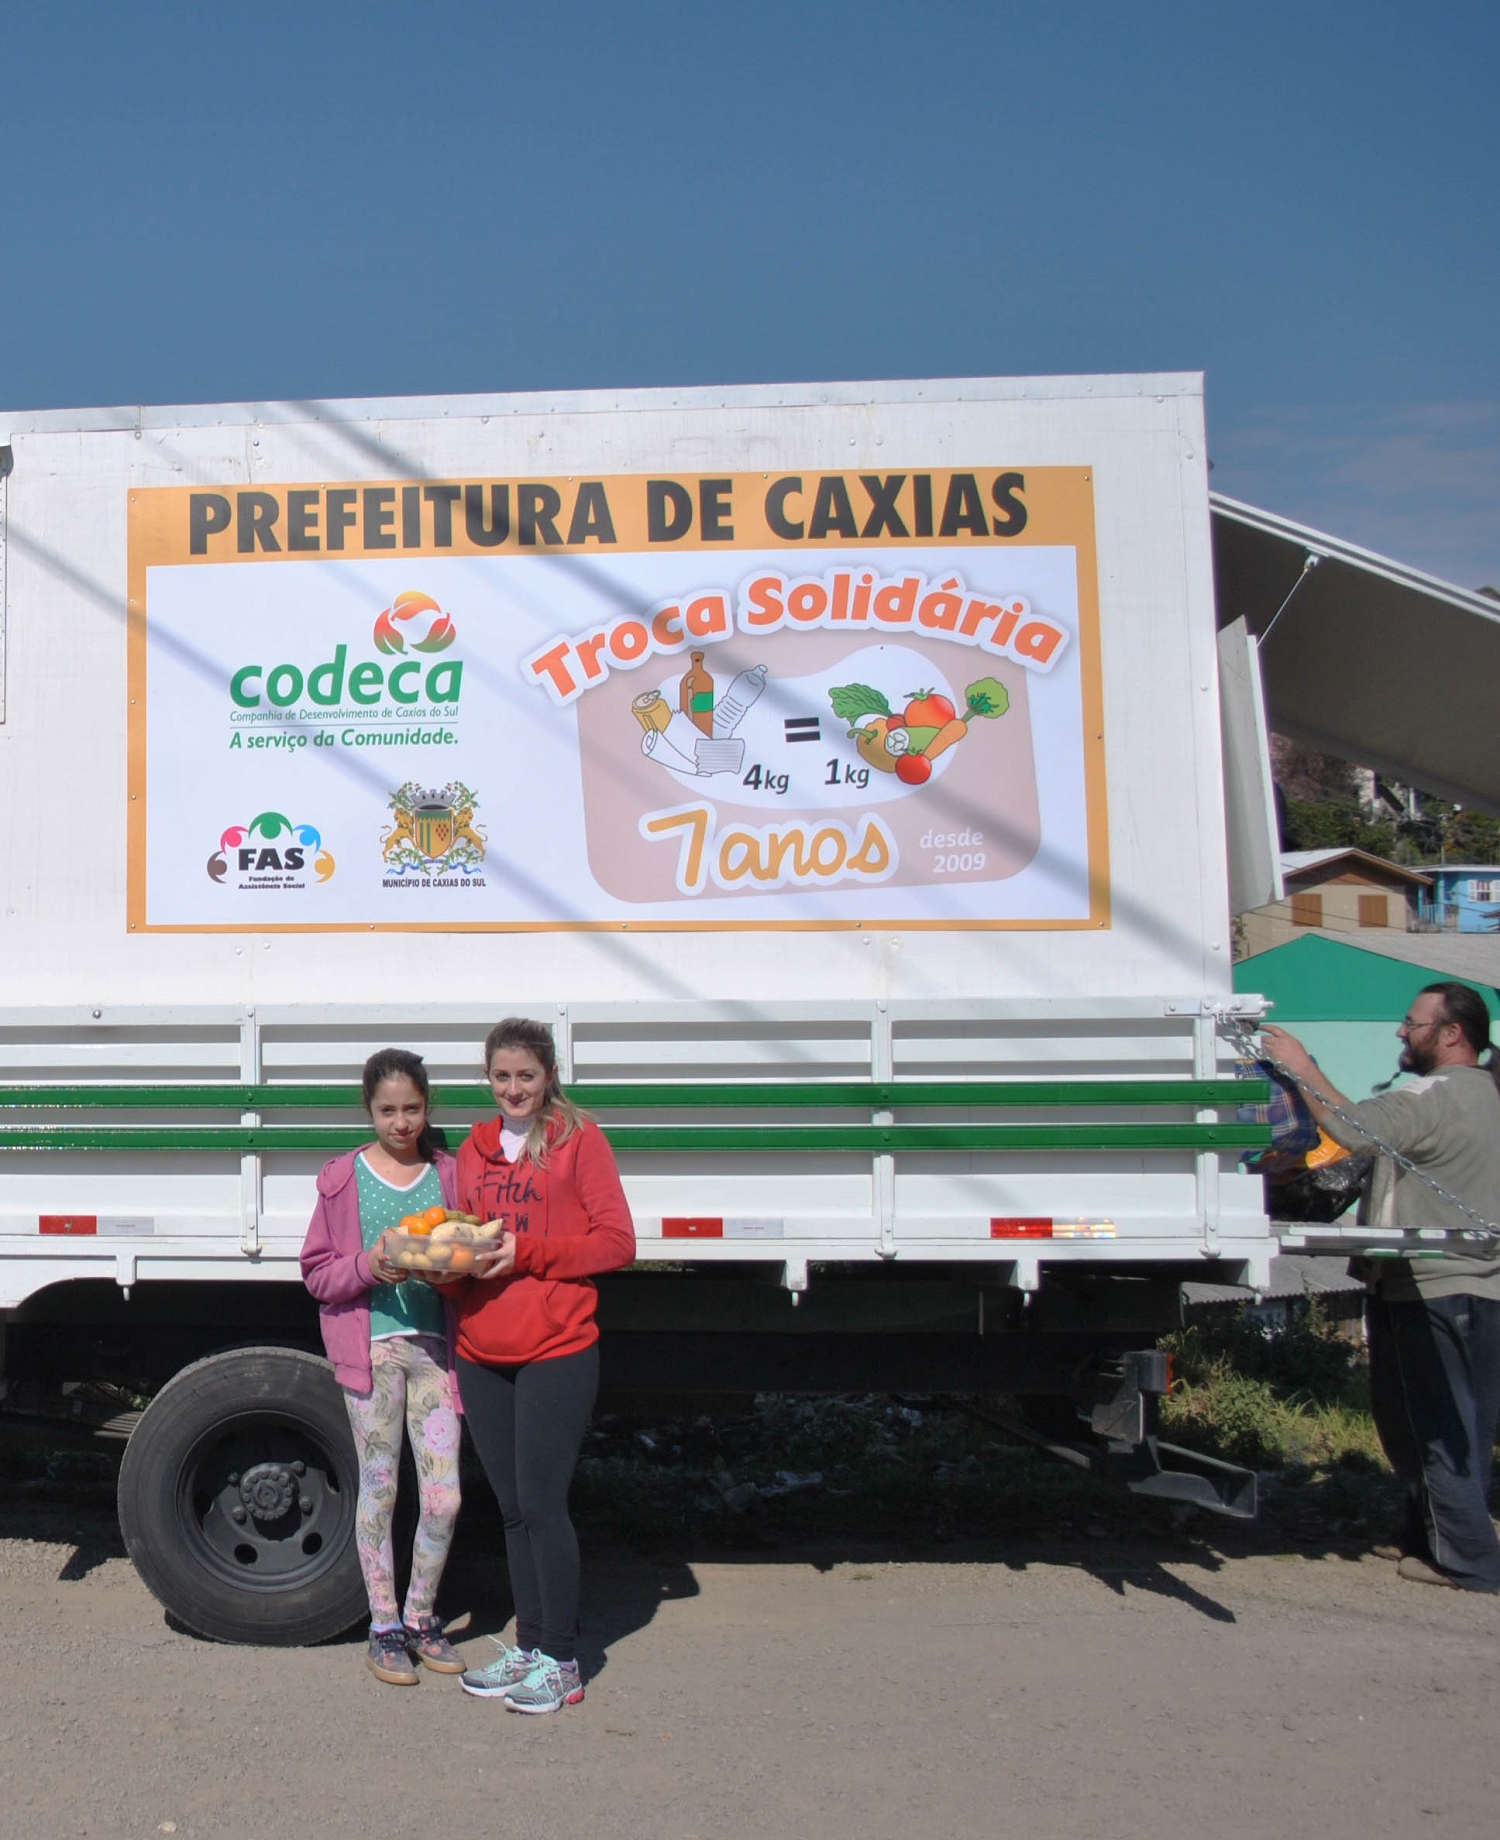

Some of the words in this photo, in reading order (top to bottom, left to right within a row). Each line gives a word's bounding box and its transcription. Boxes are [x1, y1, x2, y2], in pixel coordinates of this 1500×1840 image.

[188, 481, 619, 556] PREFEITURA
[647, 478, 735, 543] DE
[763, 472, 1029, 541] CAXIAS
[531, 593, 727, 698] Troca
[747, 572, 1063, 665] Solidária
[229, 644, 464, 708] codeca
[229, 710, 282, 725] Companhia
[285, 711, 296, 721] de
[299, 707, 378, 720] Desenvolvimento
[381, 707, 392, 718] de
[395, 706, 427, 719] Caxias
[429, 706, 441, 717] do
[443, 705, 458, 717] Sul
[229, 731, 242, 749] A
[247, 731, 307, 753] serviço
[313, 729, 335, 747] da
[341, 727, 459, 746] Comunidade.
[743, 764, 790, 795] 4kg
[824, 759, 870, 789] 1kg
[647, 810, 708, 887] 7
[718, 822, 890, 882] anos
[920, 828, 983, 849] desde
[238, 848, 305, 871] FAS
[932, 853, 986, 874] 2009
[238, 882, 281, 890] Assistência
[248, 875, 283, 883] Fundação
[382, 877, 419, 888] MUNICÍPIO
[421, 878, 431, 887] DE
[433, 878, 459, 887] CAXIAS
[461, 878, 470, 887] DO
[472, 877, 487, 887] SUL
